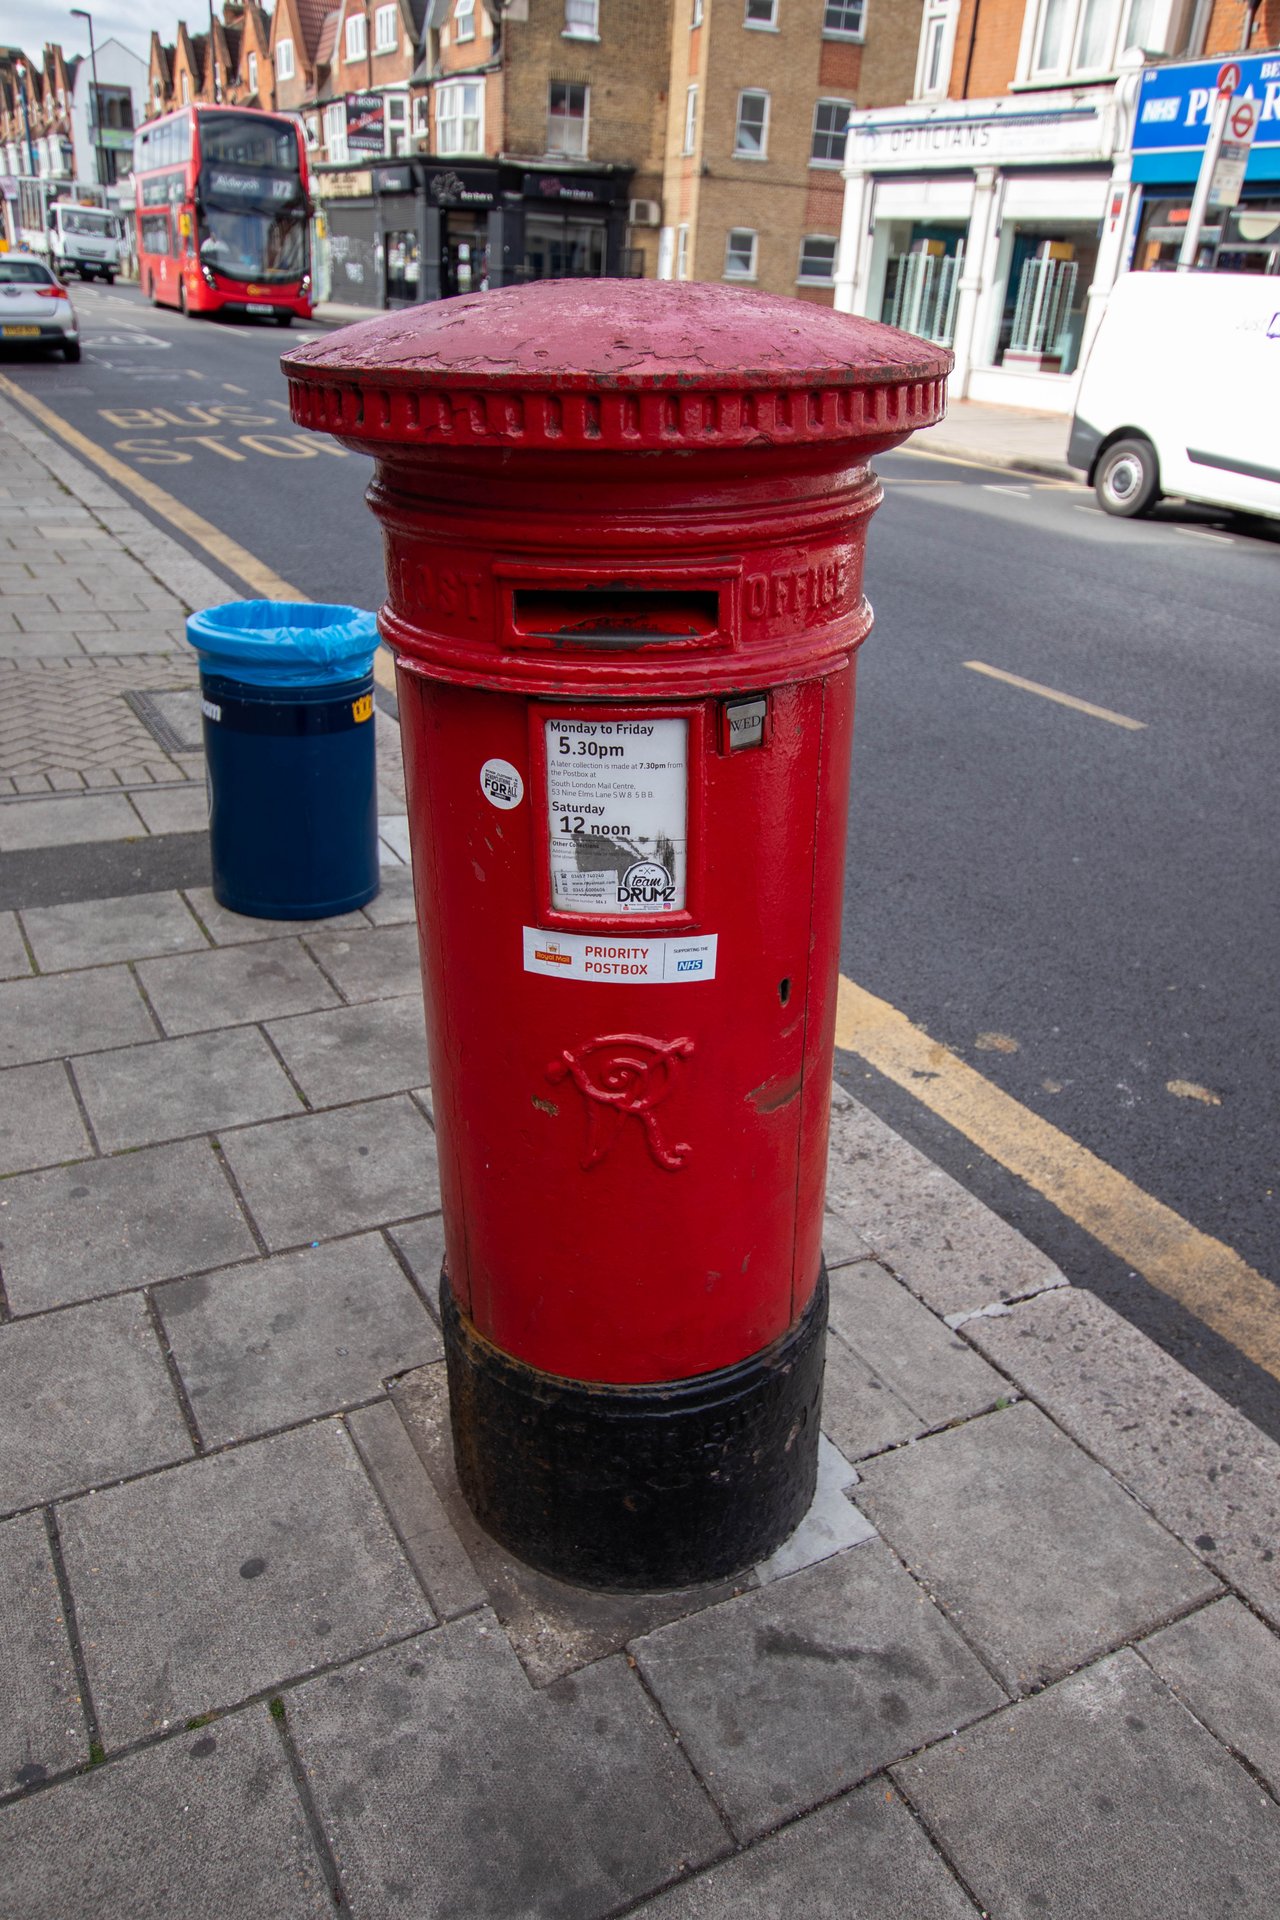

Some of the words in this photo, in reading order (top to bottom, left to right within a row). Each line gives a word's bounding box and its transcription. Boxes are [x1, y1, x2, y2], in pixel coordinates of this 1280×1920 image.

[1221, 66, 1237, 90] A
[1141, 97, 1181, 123] NHS
[890, 123, 993, 151] OPTICIANS
[216, 175, 260, 190] Aldwych
[98, 405, 277, 430] BUS
[550, 721, 597, 736] Monday
[600, 724, 613, 734] to
[616, 723, 654, 736] Friday
[731, 715, 761, 732] WED
[559, 736, 624, 759] 5.30pm
[572, 761, 603, 769] collection
[639, 762, 666, 770] 7.30pm
[667, 761, 684, 769] from
[562, 770, 589, 778] Postbox
[484, 779, 507, 795] FOR
[551, 779, 571, 787] South
[571, 781, 596, 789] London
[612, 782, 636, 790] Centre,
[551, 788, 561, 796] 53
[578, 790, 594, 798] Elms
[552, 801, 605, 816] Saturday
[559, 815, 585, 834] 12
[590, 824, 631, 835] noon
[552, 840, 568, 848] Other
[631, 875, 662, 887] team
[617, 887, 676, 902] DRUMZ
[536, 952, 555, 961] Royal
[555, 955, 570, 963] Mail
[585, 946, 649, 959] PRIORITY
[585, 962, 648, 975] POSTBOX
[678, 960, 702, 970] NHS
